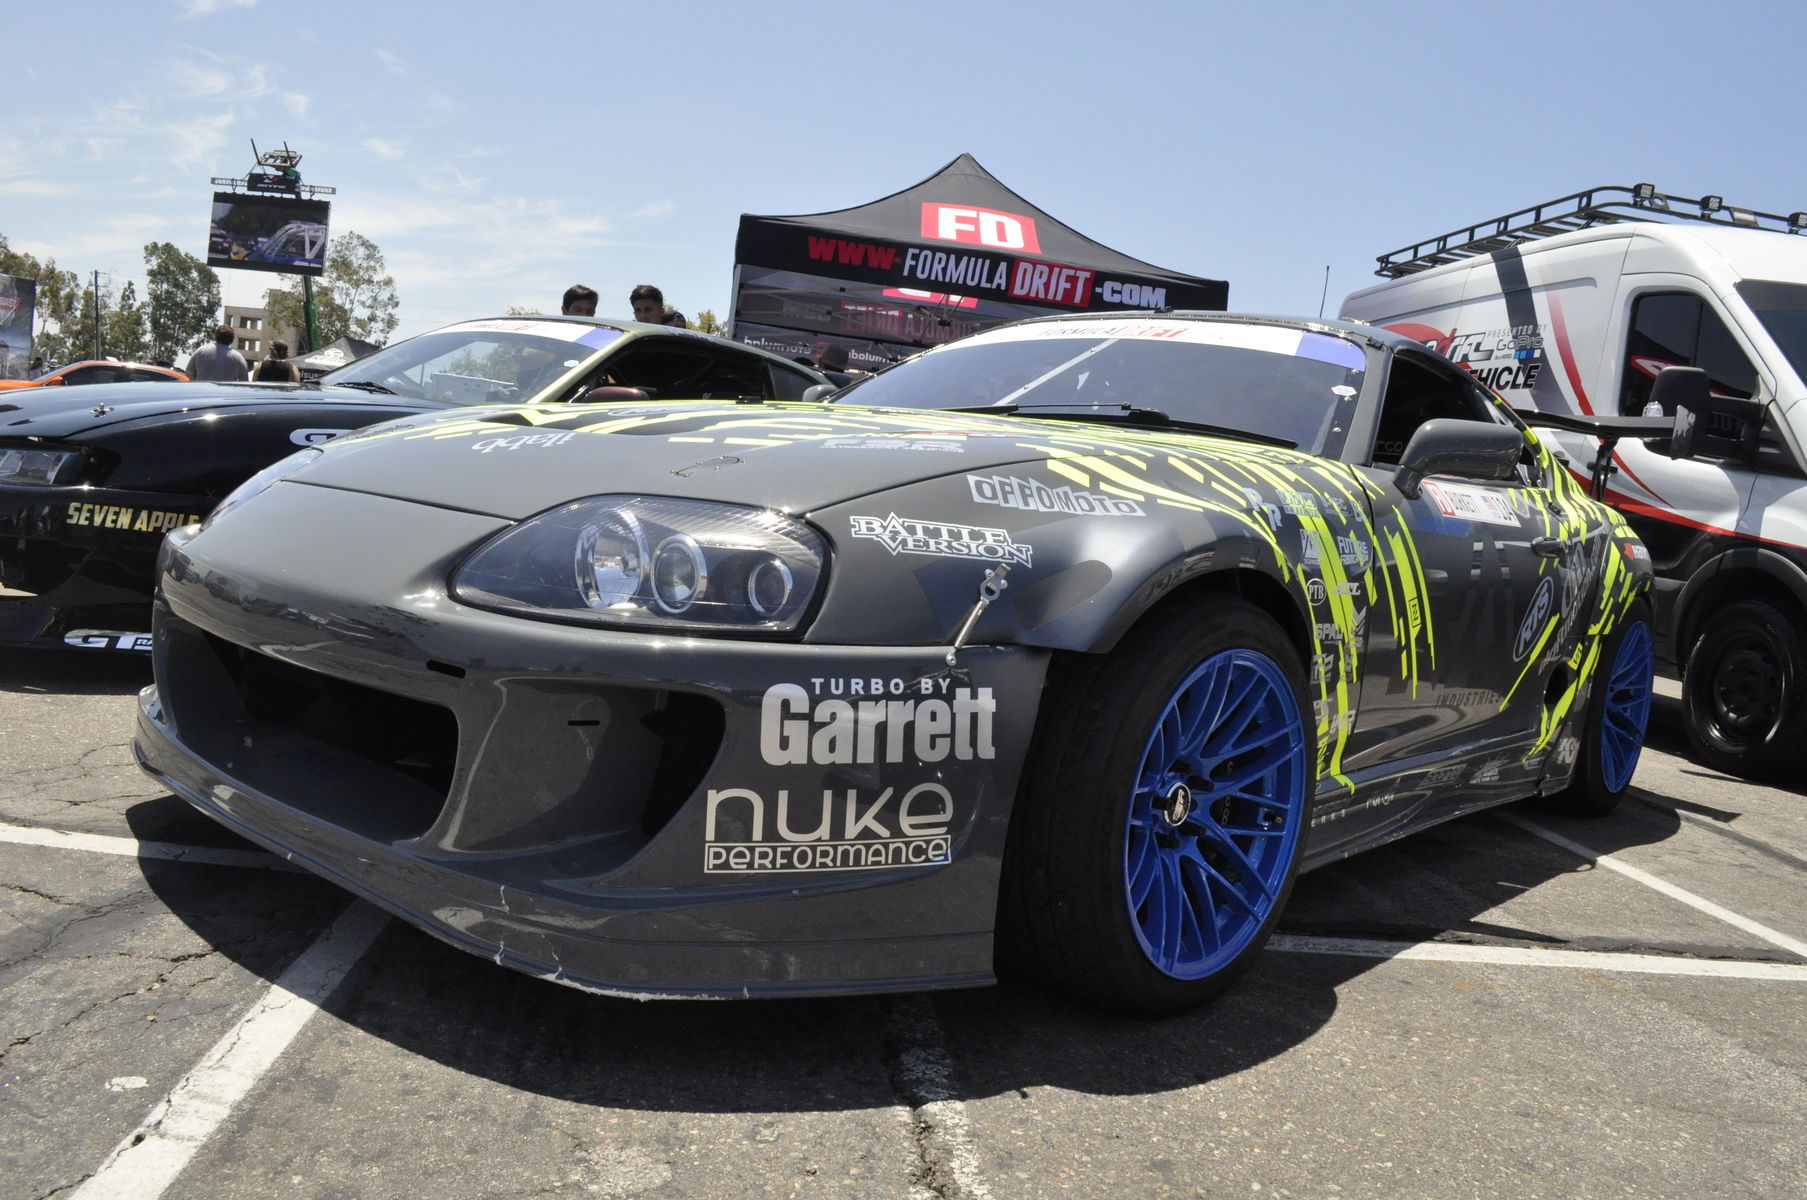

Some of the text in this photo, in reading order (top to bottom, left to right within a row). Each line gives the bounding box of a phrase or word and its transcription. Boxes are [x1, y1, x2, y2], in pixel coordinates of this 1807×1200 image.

[938, 206, 1024, 249] FD
[903, 248, 1007, 291] FORMULA
[1012, 264, 1092, 304] DRIFT
[1496, 335, 1543, 351] GoPro
[1466, 364, 1541, 391] EHICLE
[66, 502, 133, 530] SEVEN
[850, 512, 1008, 546] BATTLE
[876, 533, 1033, 568] VERSION
[1309, 584, 1324, 600] PTB
[811, 677, 951, 696] TURBO BY
[760, 682, 997, 766] Garrett
[705, 782, 954, 842] nuke
[708, 838, 947, 870] PERFORMANCE
